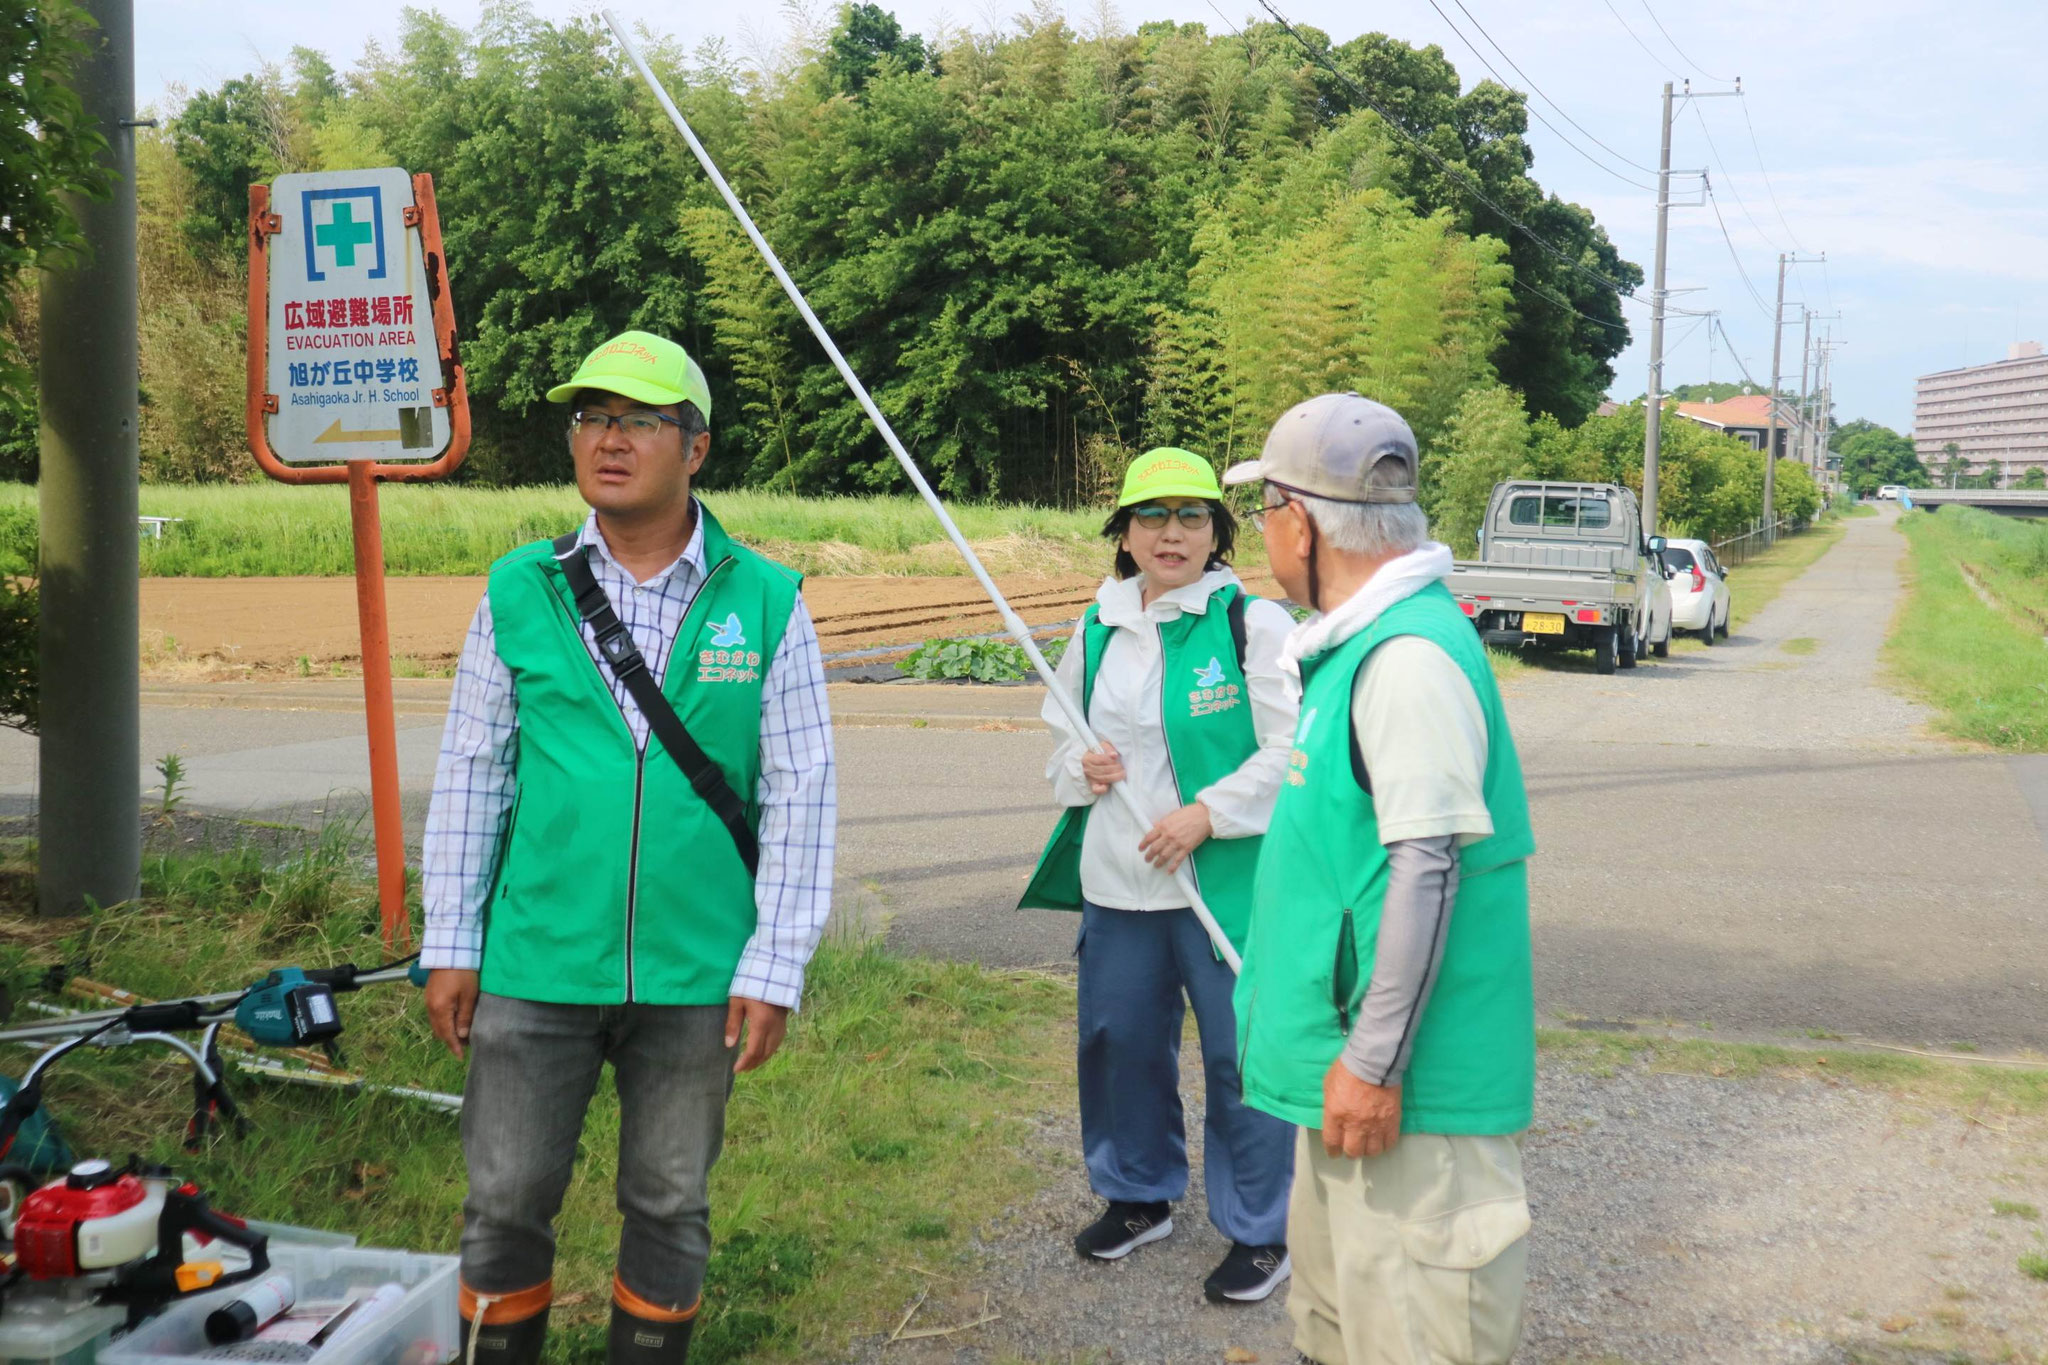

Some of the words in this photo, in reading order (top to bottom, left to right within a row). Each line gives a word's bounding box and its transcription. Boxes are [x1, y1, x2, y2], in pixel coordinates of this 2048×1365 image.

[284, 294, 413, 331] 広域避難場所
[286, 332, 374, 351] EVACUATION
[378, 330, 416, 346] AREA
[288, 357, 420, 388] 旭が丘中学校
[291, 391, 350, 408] Asahigaoka
[352, 390, 366, 404] Jr.
[368, 389, 380, 403] H.
[383, 388, 420, 403] School
[697, 667, 759, 683] エコネット
